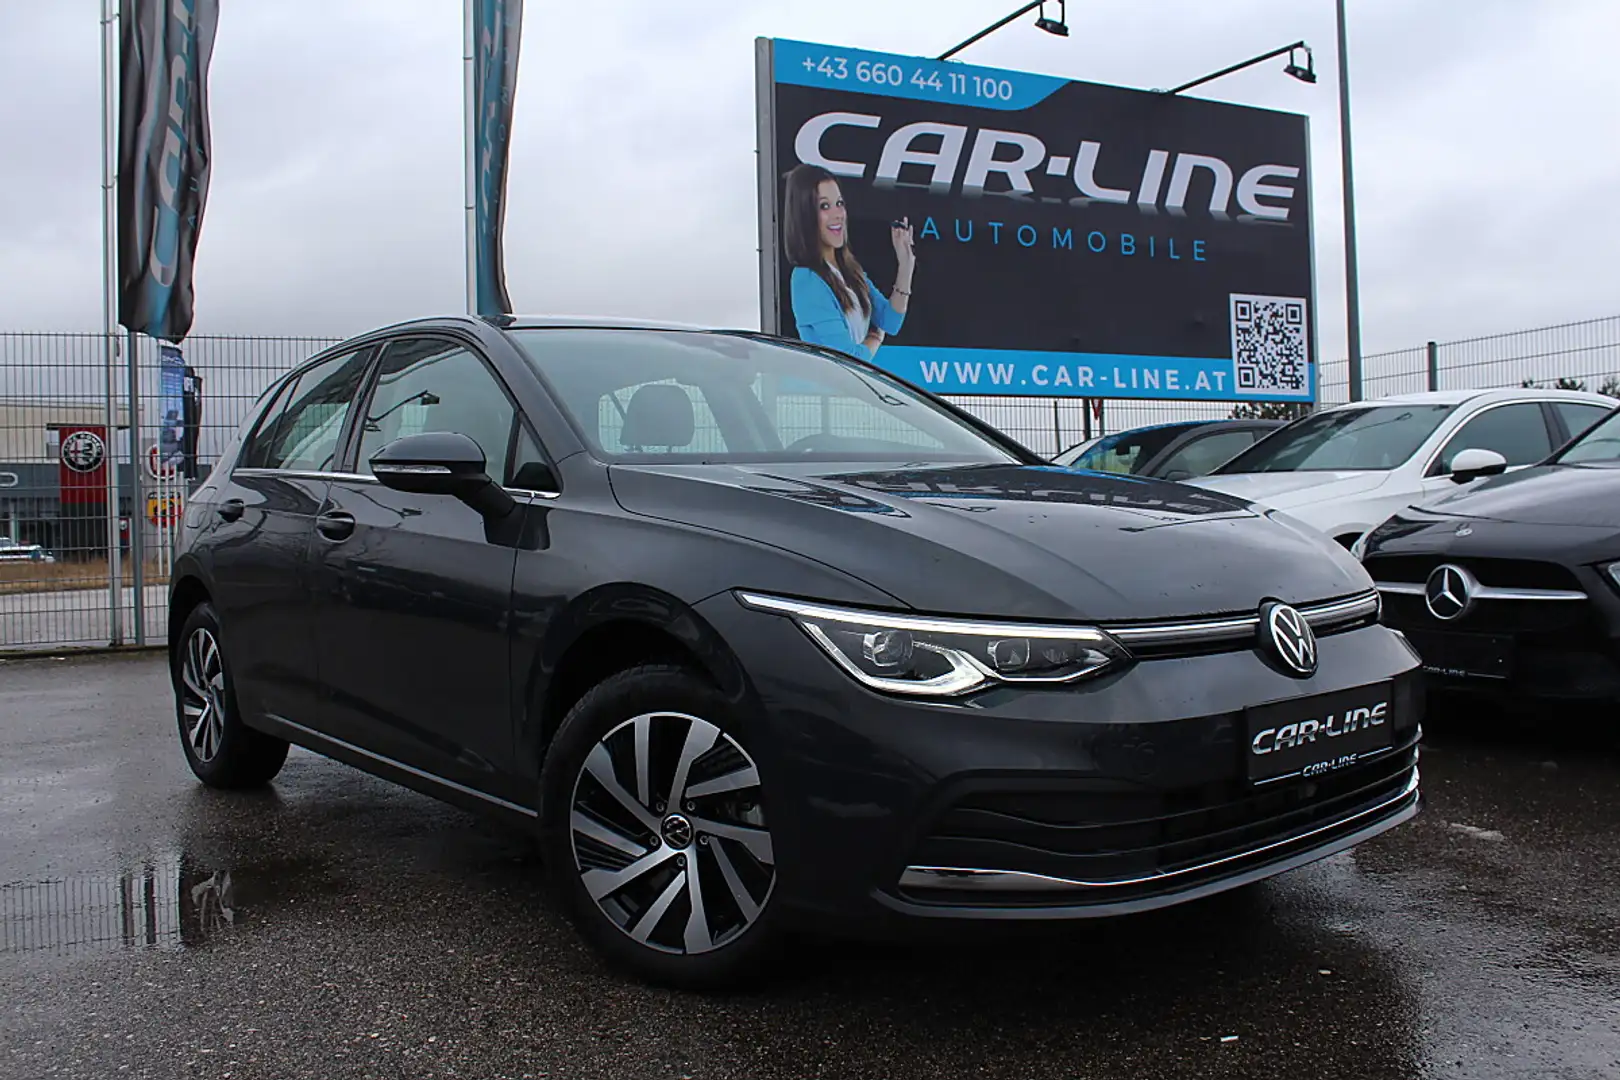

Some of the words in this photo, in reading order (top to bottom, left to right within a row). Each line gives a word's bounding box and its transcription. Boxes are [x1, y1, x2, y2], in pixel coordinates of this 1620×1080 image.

[802, 56, 848, 80] +43
[855, 60, 903, 86] 660
[910, 67, 943, 92] 44
[949, 72, 967, 95] 11
[973, 75, 1013, 101] 100
[919, 216, 1207, 262] AUTOMOBILE
[919, 360, 1227, 392] WWW.CAR-LINE.AT
[1251, 701, 1388, 755] CAR-LINE
